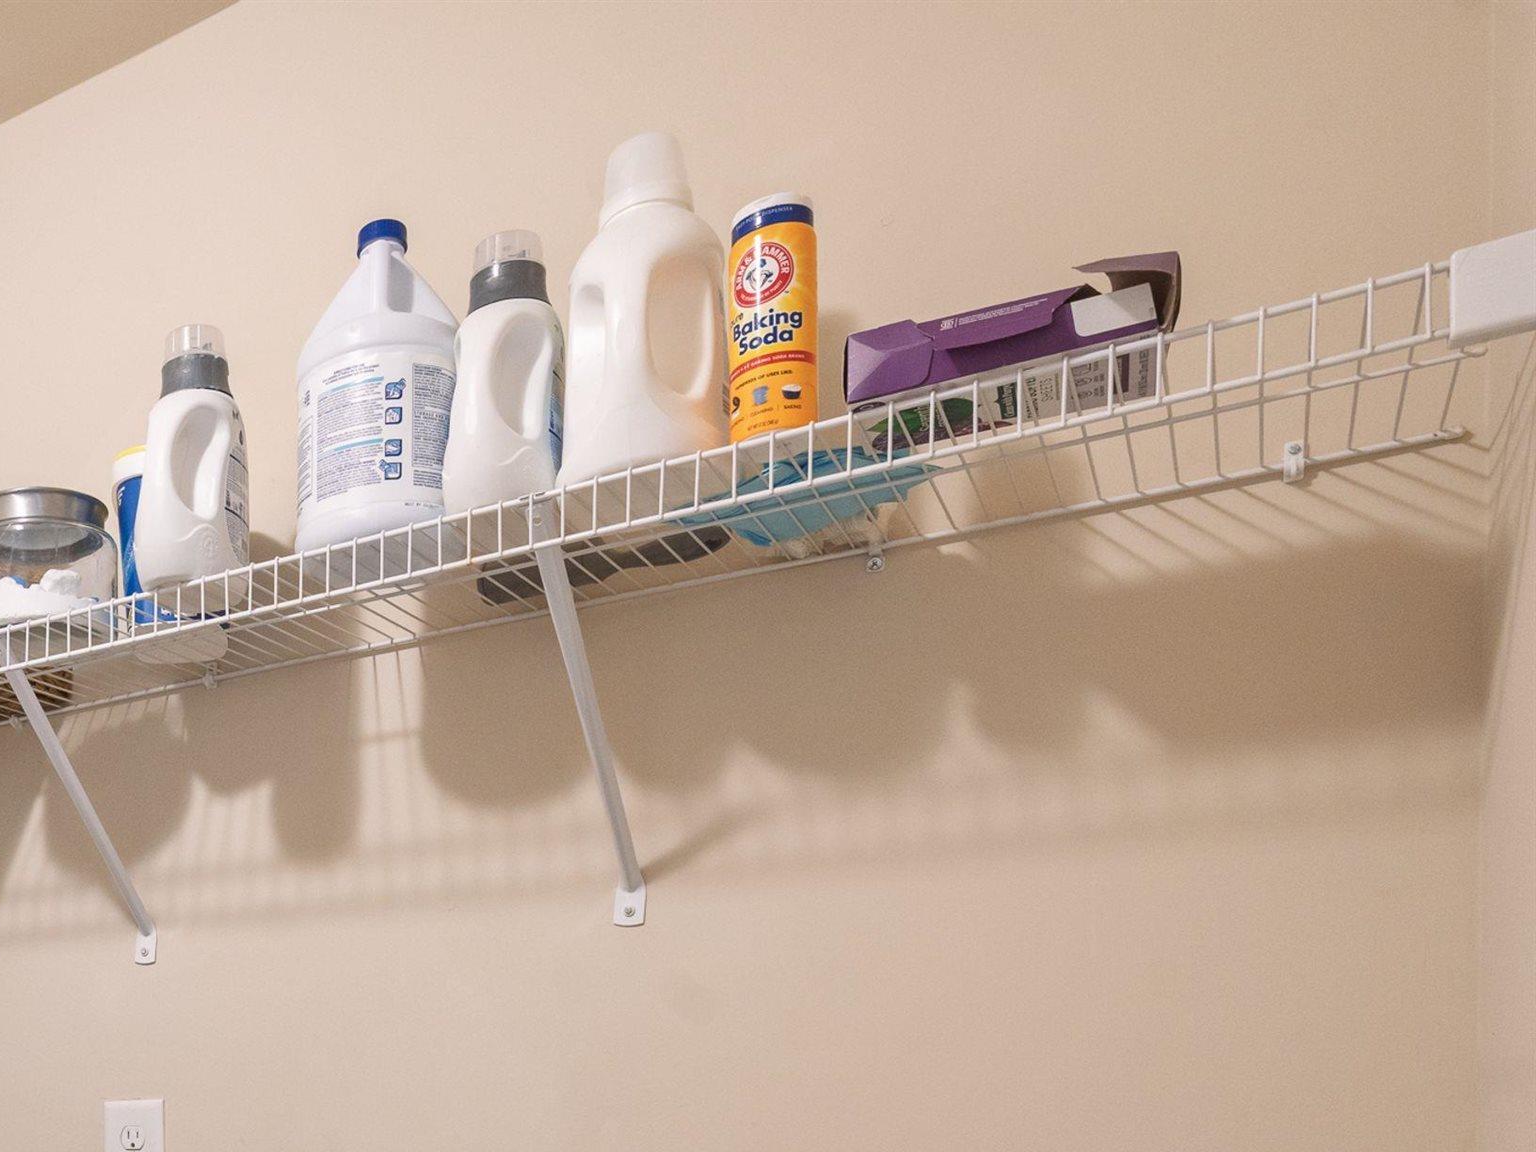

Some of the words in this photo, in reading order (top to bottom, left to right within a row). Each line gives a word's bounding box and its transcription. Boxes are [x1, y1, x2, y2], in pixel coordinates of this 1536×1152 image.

[754, 245, 790, 275] AMMER
[733, 308, 803, 343] Baking
[739, 326, 794, 356] Soda
